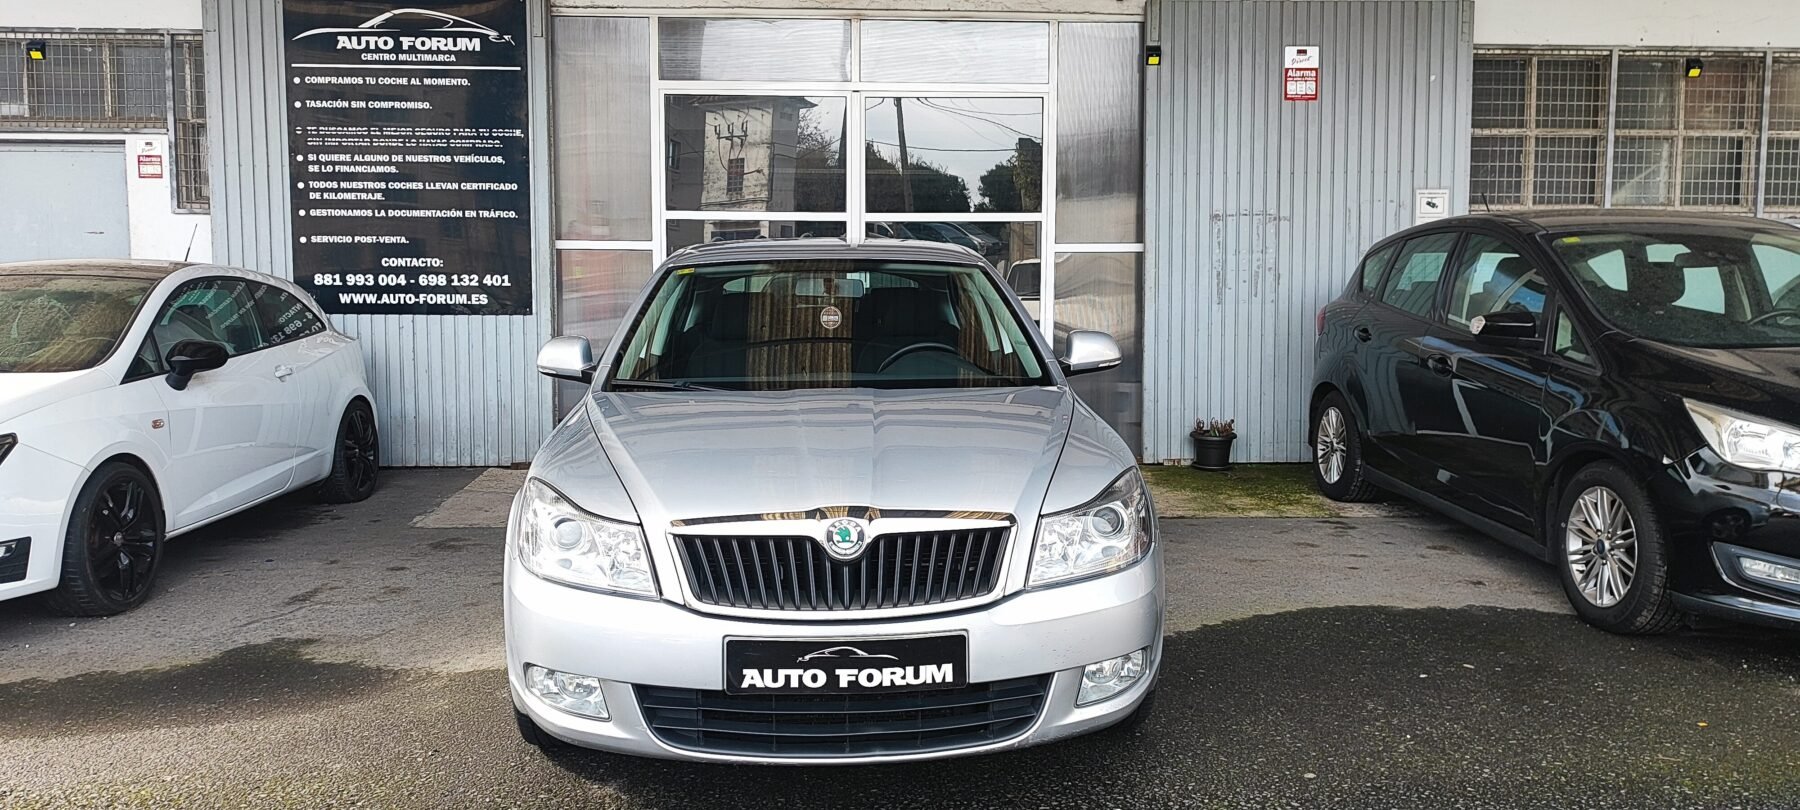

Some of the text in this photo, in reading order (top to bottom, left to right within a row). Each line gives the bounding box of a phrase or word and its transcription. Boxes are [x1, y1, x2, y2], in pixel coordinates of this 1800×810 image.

[337, 36, 480, 51] AUTO FORUM
[1288, 69, 1316, 77] Alarma
[305, 76, 363, 84] COMPRAMOS
[378, 77, 408, 85] COCHE
[305, 99, 349, 108] TASACIÓN
[368, 101, 432, 109] COMPROMISO.
[319, 154, 351, 162] QUIERE
[353, 154, 389, 162] ALGUNO
[453, 154, 505, 164] VEHÍCULOS,
[335, 165, 399, 173] FINANCIAMOS.
[323, 192, 385, 200] KILOMETRAJE.
[388, 209, 463, 217] DOCUMENTACIÓN
[478, 209, 518, 218] TRÁFICO.
[381, 258, 443, 267] CONTACTO:
[314, 274, 342, 285] 881
[346, 274, 374, 285] 993
[378, 274, 406, 286] 004
[419, 274, 447, 286] 698
[451, 274, 479, 286] 132
[483, 274, 511, 286] 401
[339, 293, 488, 304] WWW.AUTO-FORUM.ES
[741, 663, 953, 688] AUTO FORUM
